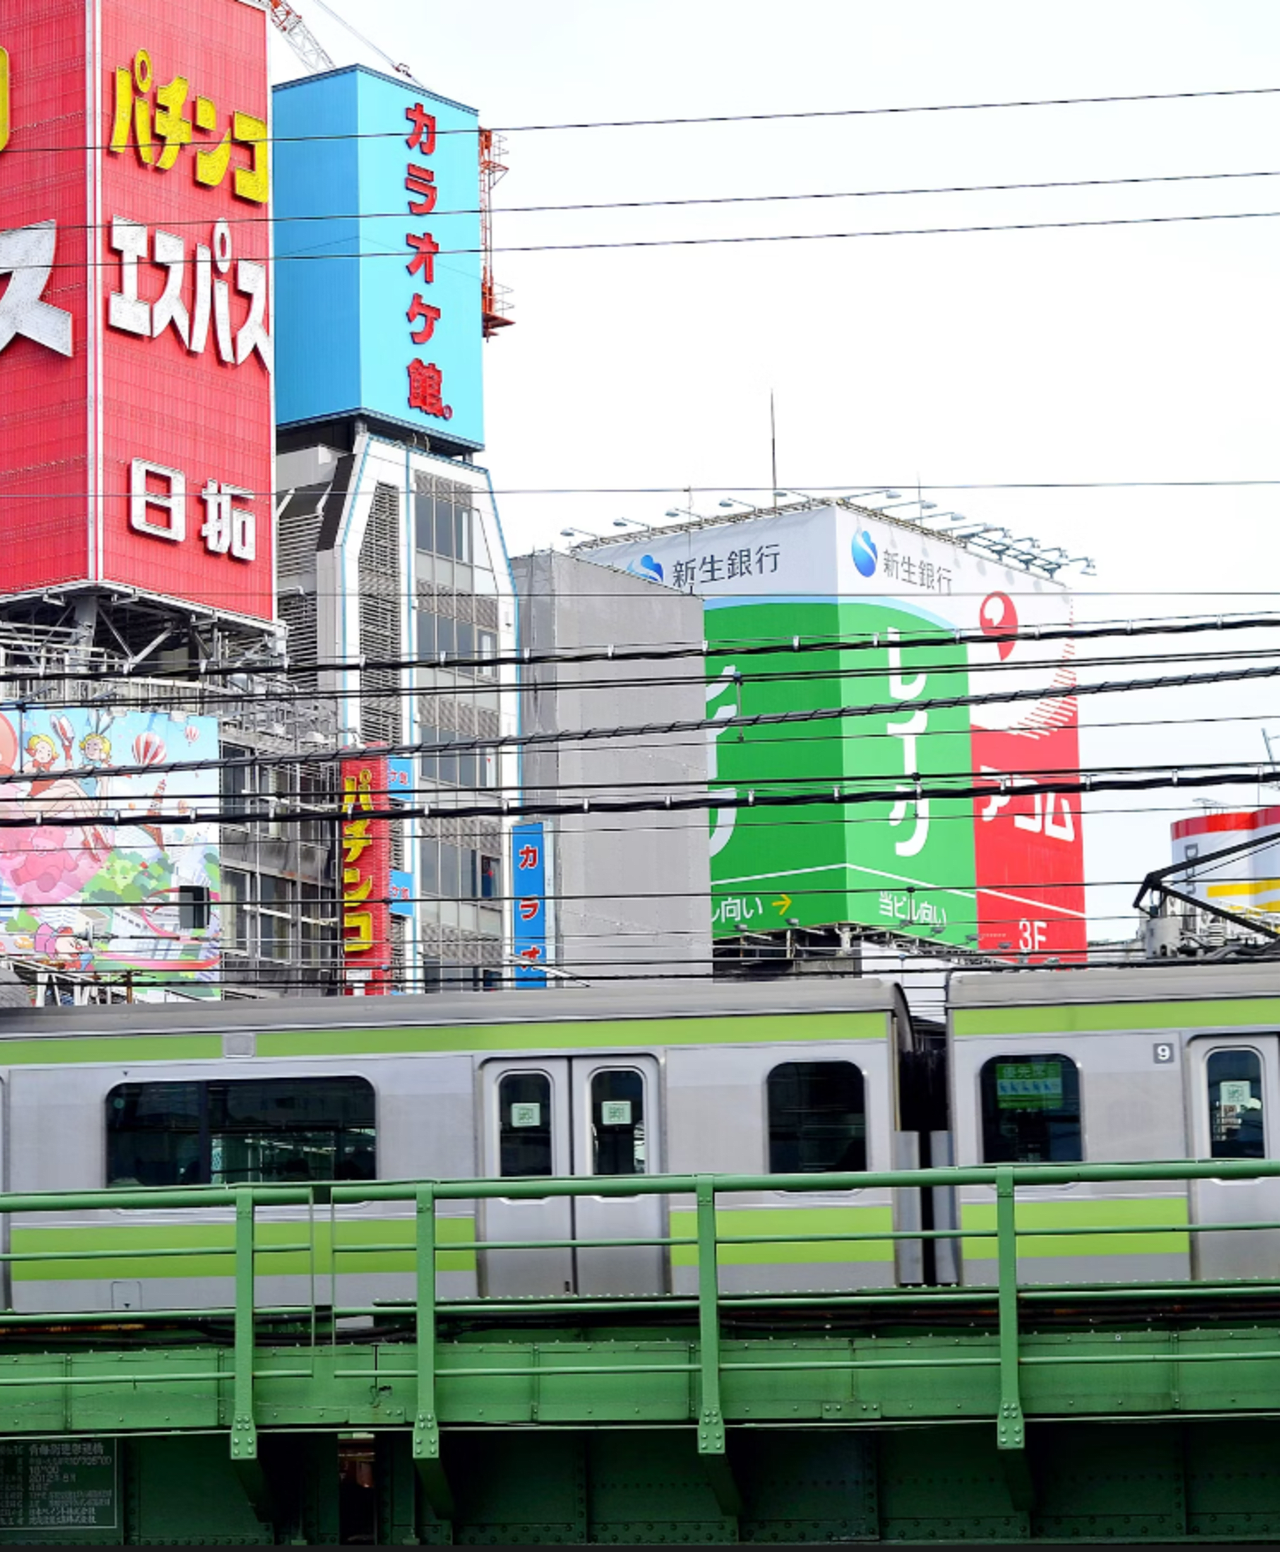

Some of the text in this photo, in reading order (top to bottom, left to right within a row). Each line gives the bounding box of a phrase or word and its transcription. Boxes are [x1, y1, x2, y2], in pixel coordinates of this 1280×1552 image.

[109, 48, 269, 204] パチンコ
[109, 214, 270, 375] エスパス
[129, 457, 257, 562] 日拓
[672, 544, 780, 587] 新生銀行
[881, 549, 952, 596] 新生銀行
[886, 627, 930, 857] レイク
[980, 765, 1075, 842] アコム
[341, 768, 373, 952] パチンコ
[879, 892, 947, 926] 当ビル向い
[1019, 918, 1047, 953] 3F
[1157, 1045, 1170, 1060] 9
